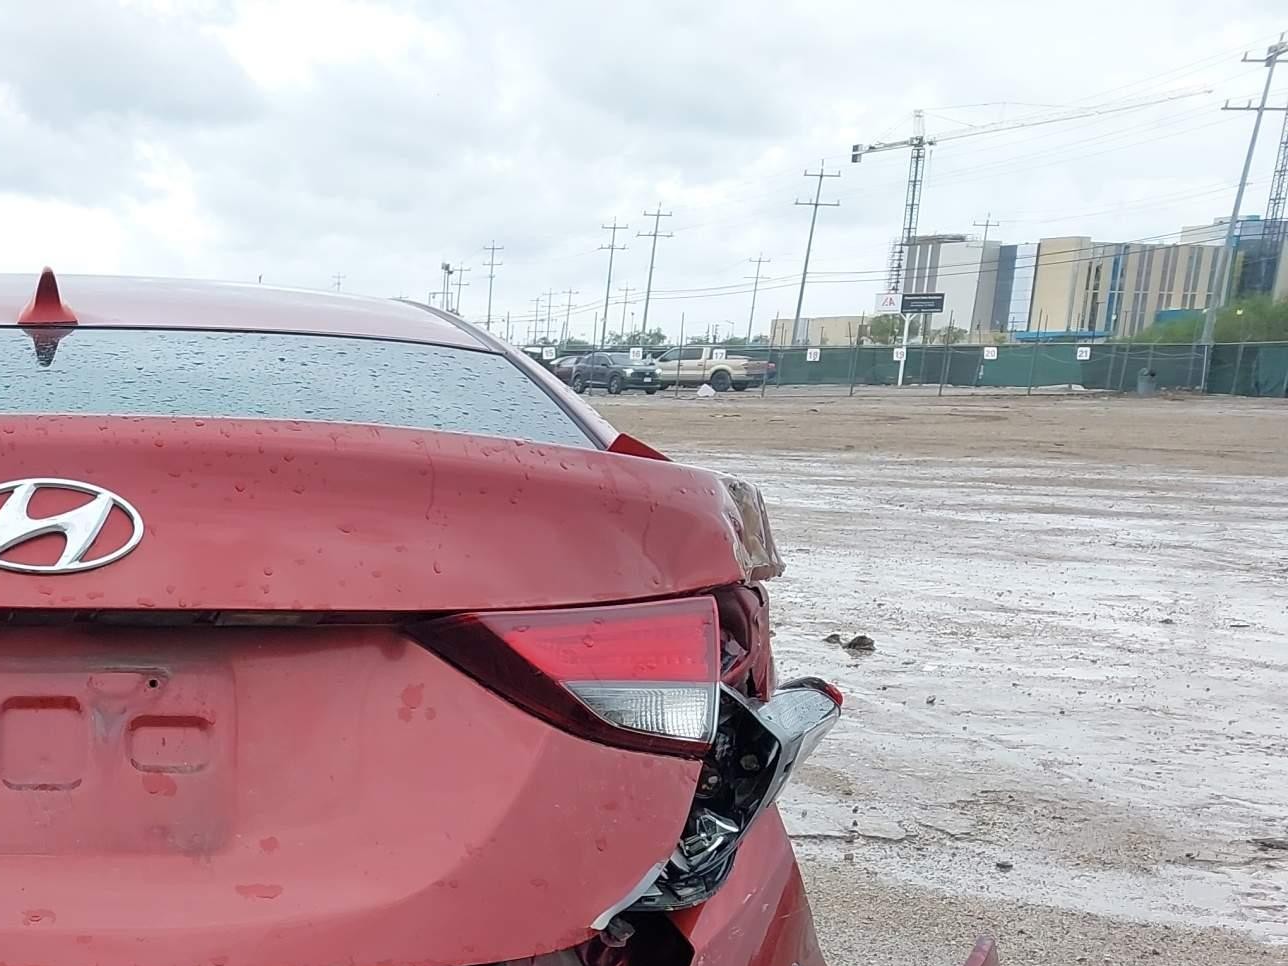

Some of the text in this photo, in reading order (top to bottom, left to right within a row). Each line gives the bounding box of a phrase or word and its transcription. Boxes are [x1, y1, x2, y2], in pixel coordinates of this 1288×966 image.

[631, 349, 641, 358] 16
[986, 350, 996, 358] 20
[1079, 350, 1089, 358] 21
